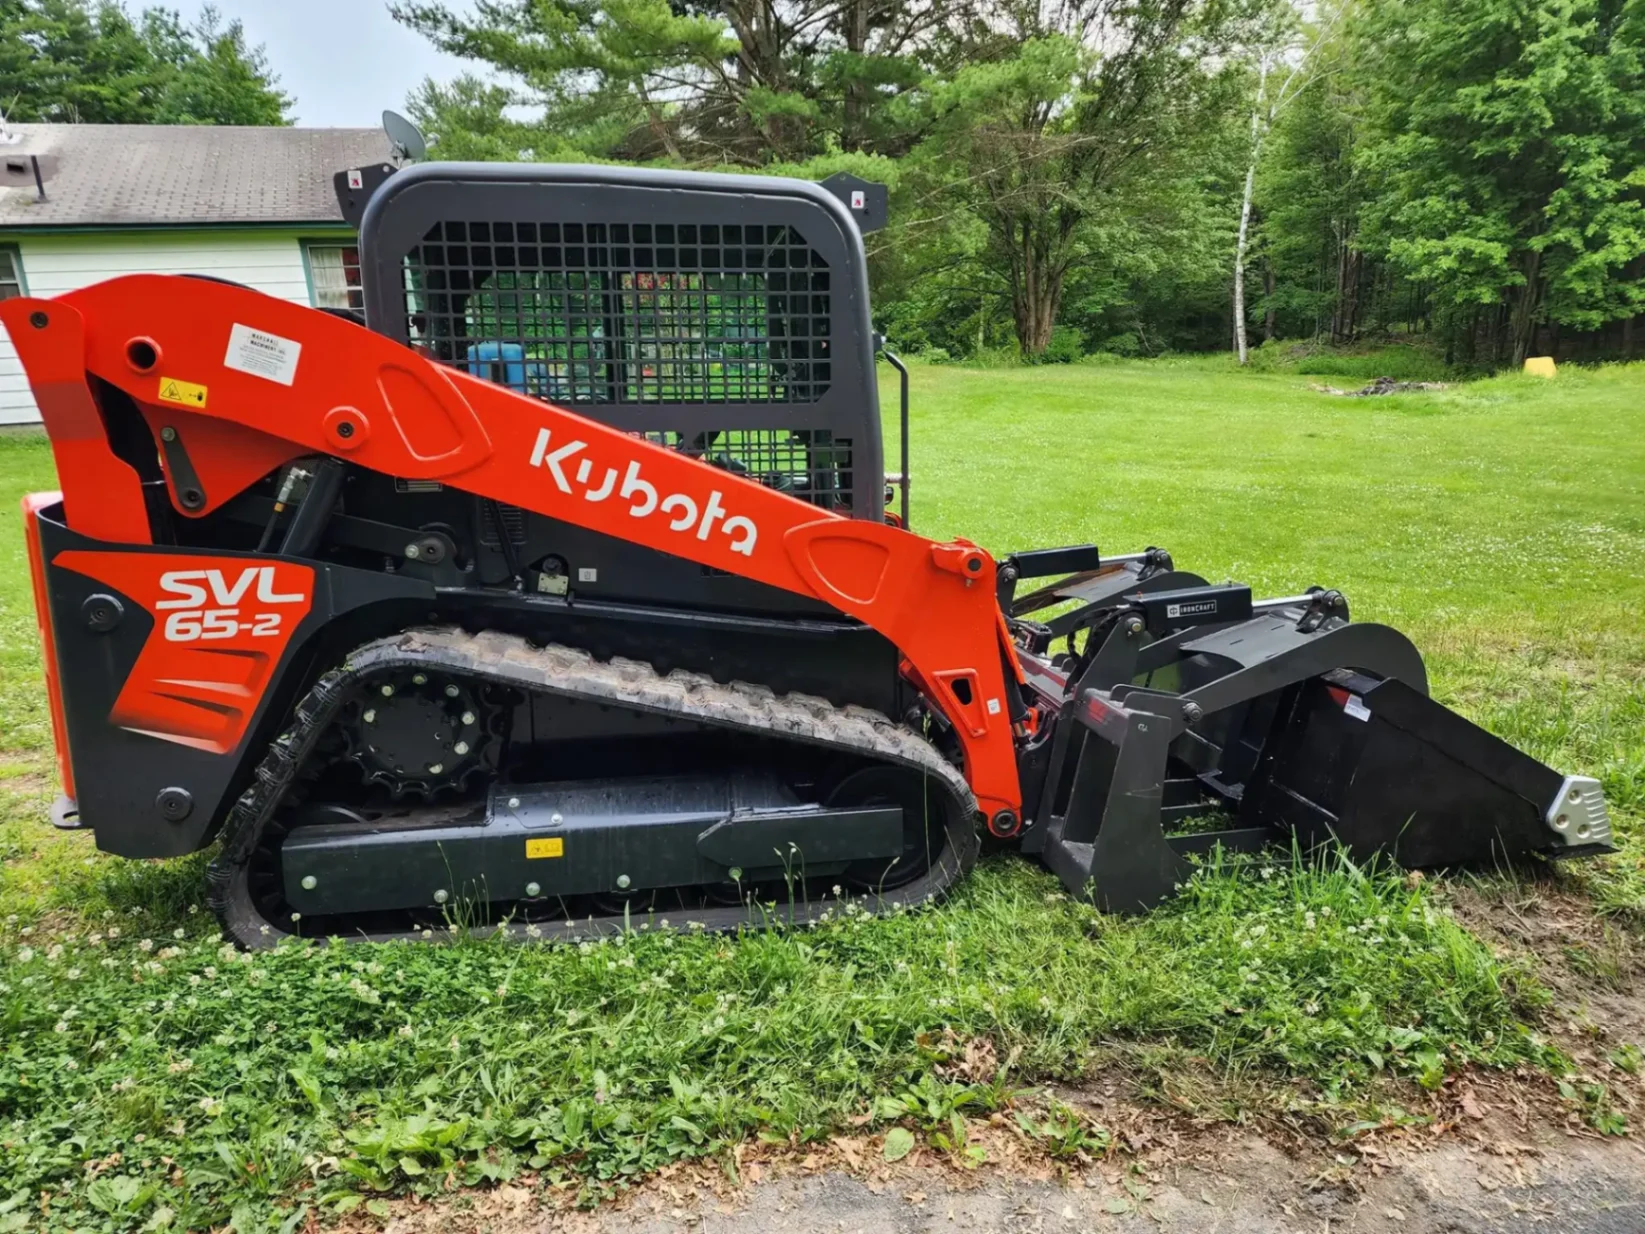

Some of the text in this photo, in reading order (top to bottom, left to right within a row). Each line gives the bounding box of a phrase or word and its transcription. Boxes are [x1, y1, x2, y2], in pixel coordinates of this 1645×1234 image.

[529, 428, 758, 556] Kubota
[155, 567, 305, 610] SVL
[164, 609, 282, 642] 65-2
[1180, 603, 1215, 613] IRONCRAFT
